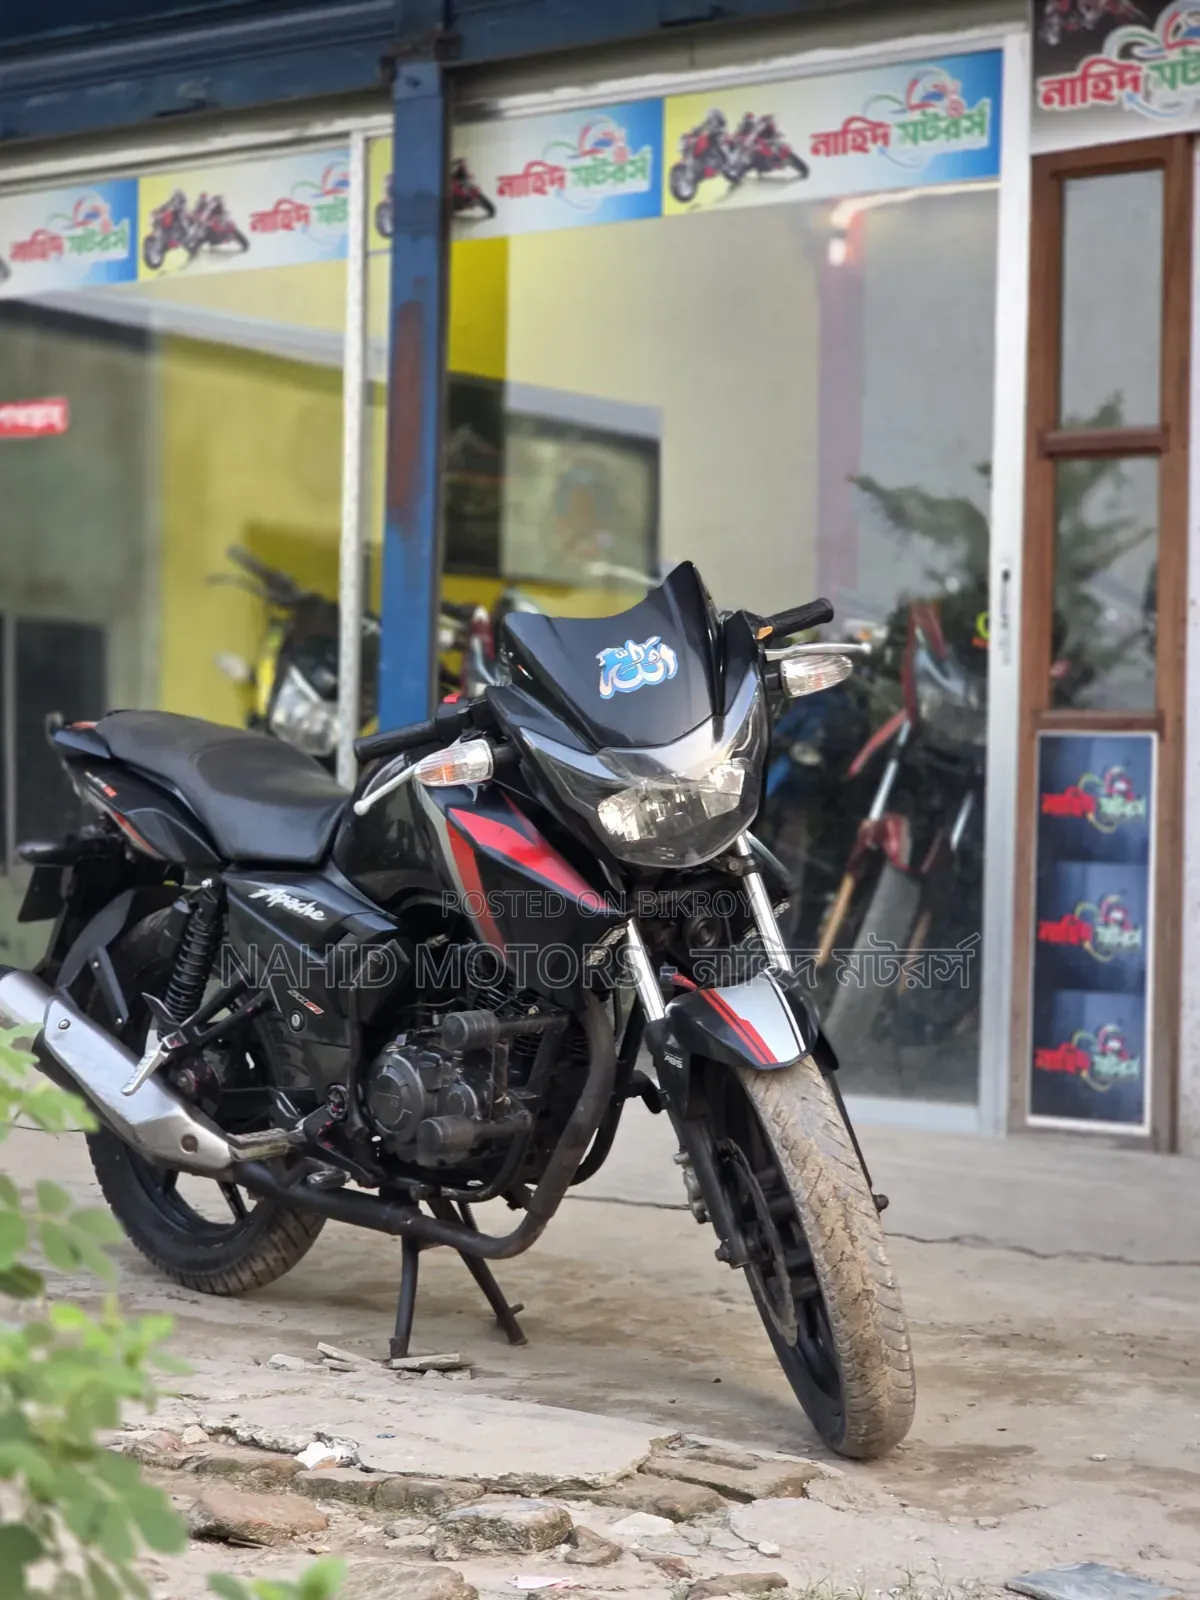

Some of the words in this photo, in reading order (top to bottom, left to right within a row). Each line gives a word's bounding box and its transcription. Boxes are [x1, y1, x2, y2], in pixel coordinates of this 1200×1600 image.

[1039, 57, 1142, 106] নাহিদ
[809, 115, 891, 157] নাহিদ
[248, 888, 327, 921] Apache
